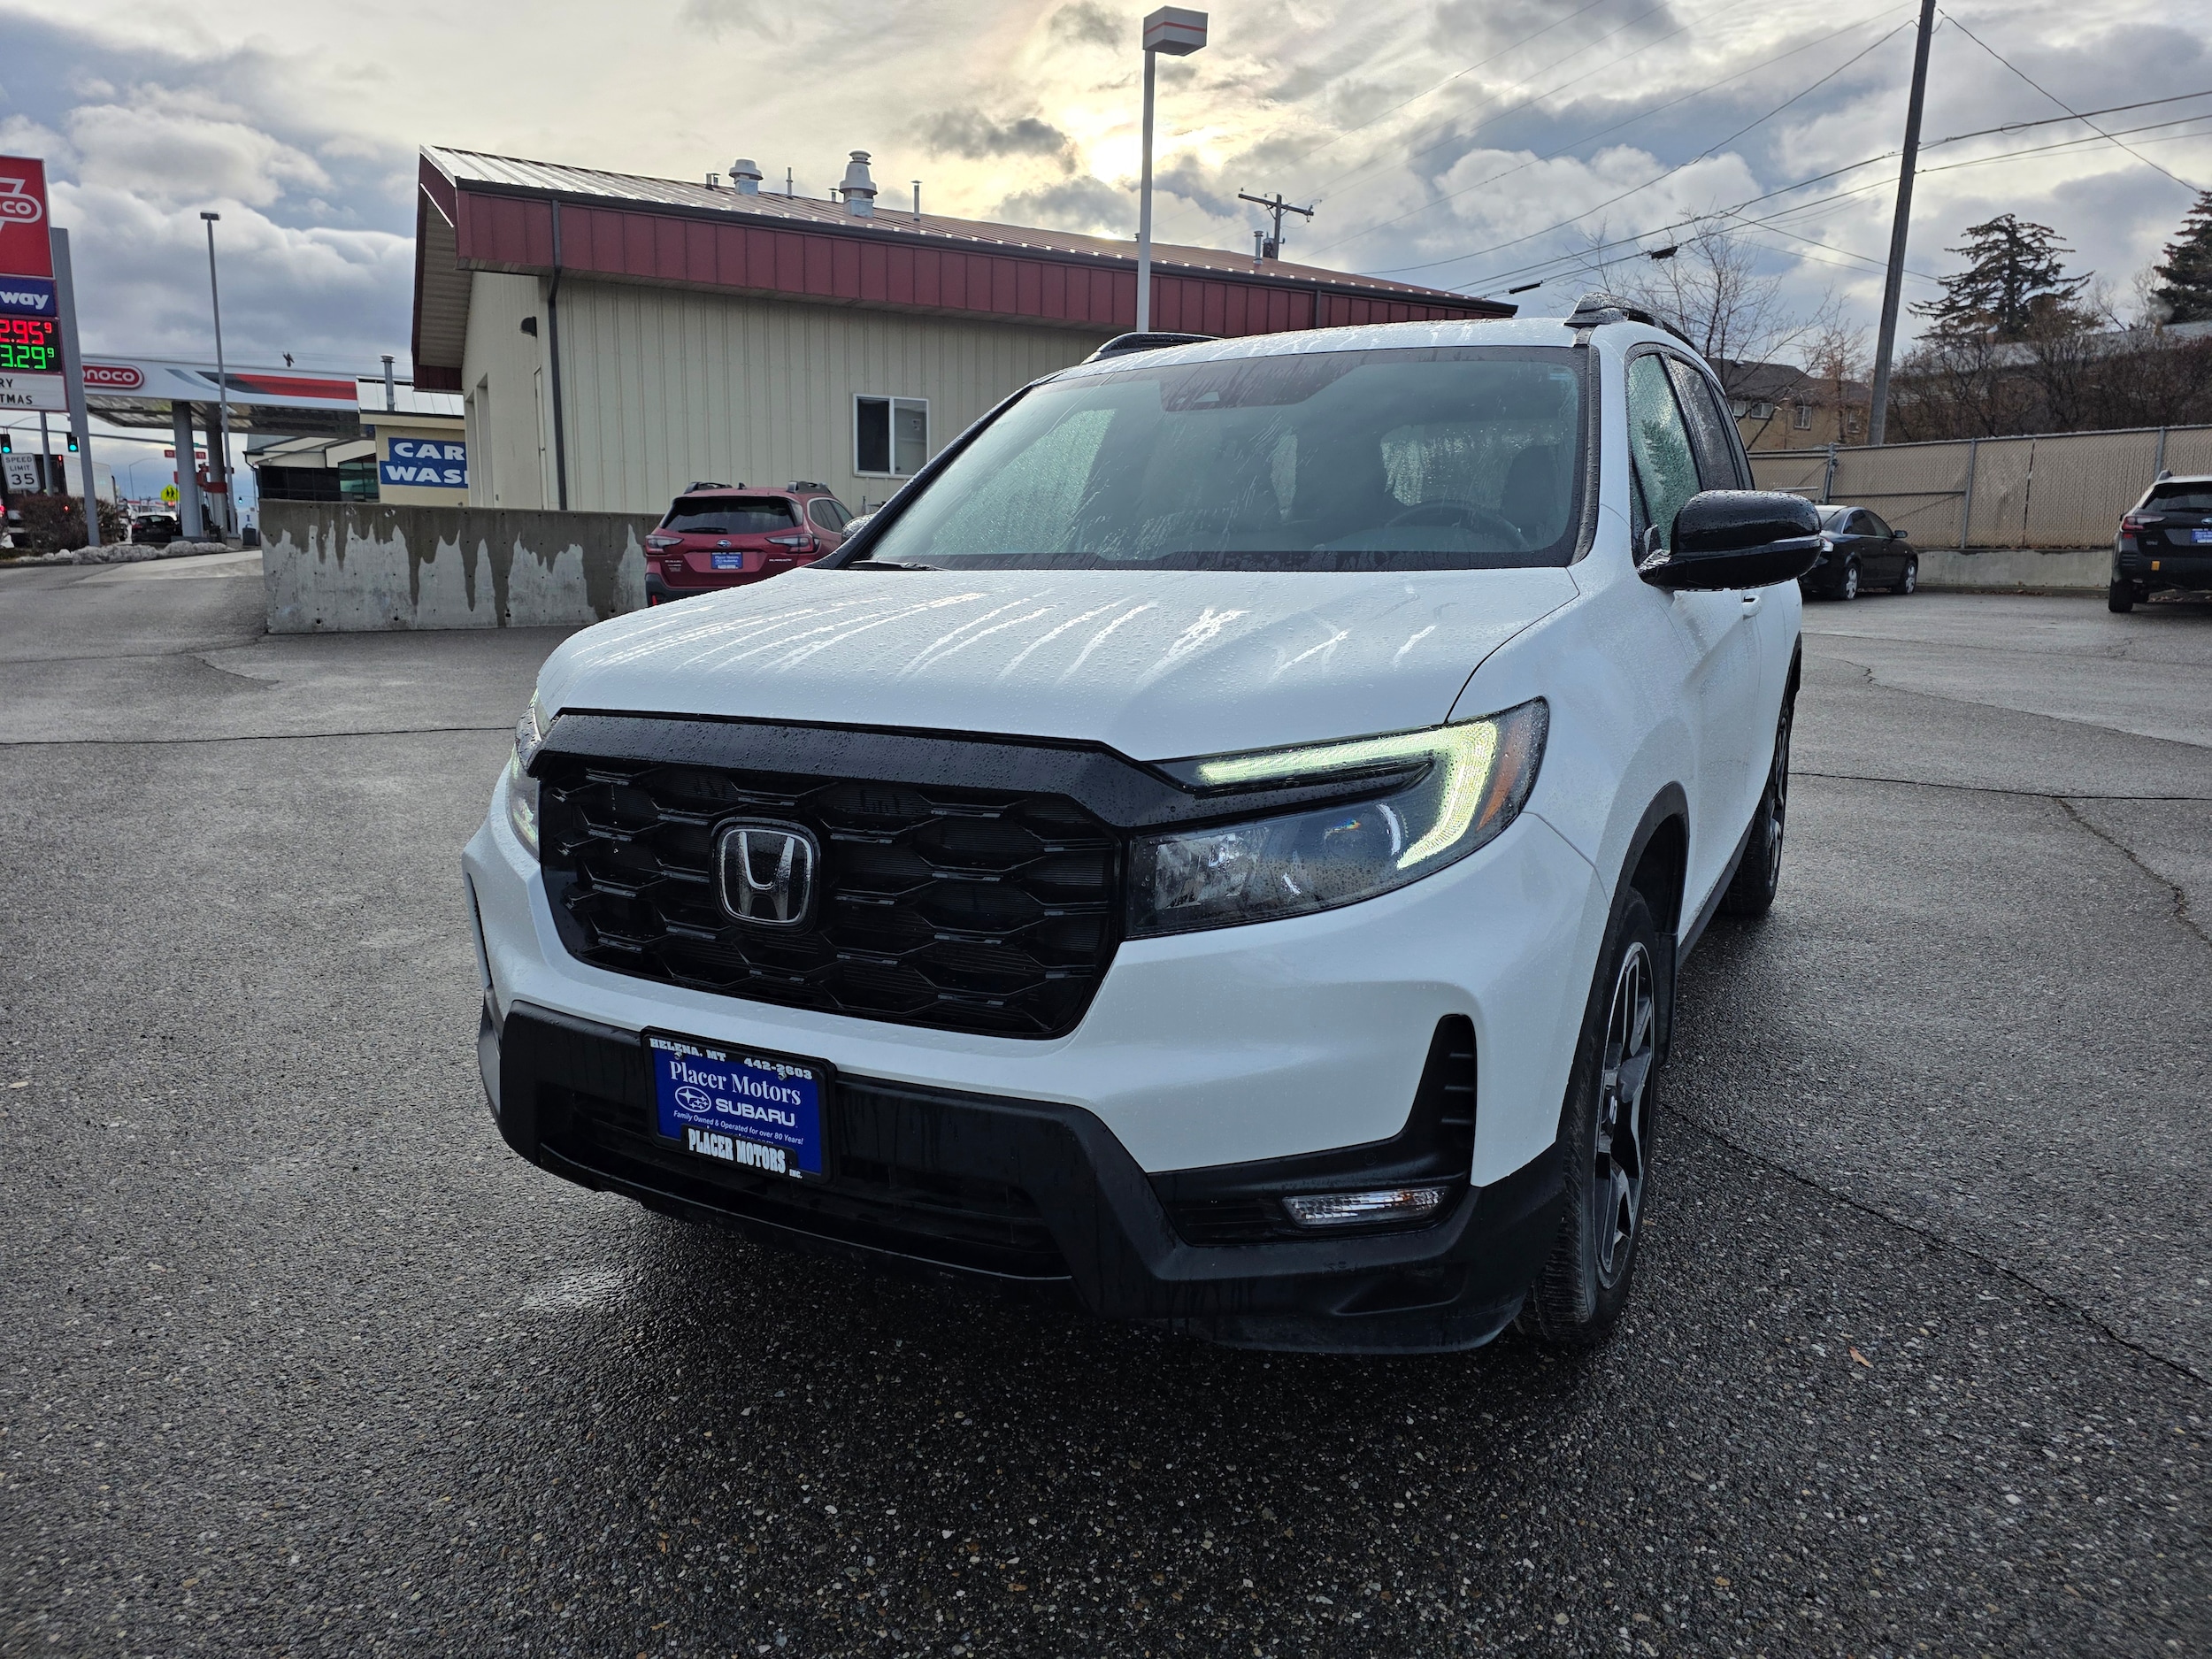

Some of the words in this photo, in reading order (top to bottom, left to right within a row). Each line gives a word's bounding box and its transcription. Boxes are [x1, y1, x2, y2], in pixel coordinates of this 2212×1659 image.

[82, 369, 135, 383] noco
[394, 442, 466, 461] CAR
[11, 473, 35, 486] 35
[706, 1049, 726, 1062] MT
[669, 1061, 726, 1091] Placer
[730, 1073, 802, 1106] Motors
[715, 1098, 795, 1127] SUBARU
[673, 1110, 693, 1122] Family
[693, 1115, 714, 1125] Owned
[720, 1120, 749, 1133] Operated
[749, 1125, 759, 1135] for
[759, 1130, 773, 1139] over
[784, 1134, 804, 1146] Years!
[687, 1128, 734, 1162] PLACER
[735, 1139, 787, 1174] MOTORS
